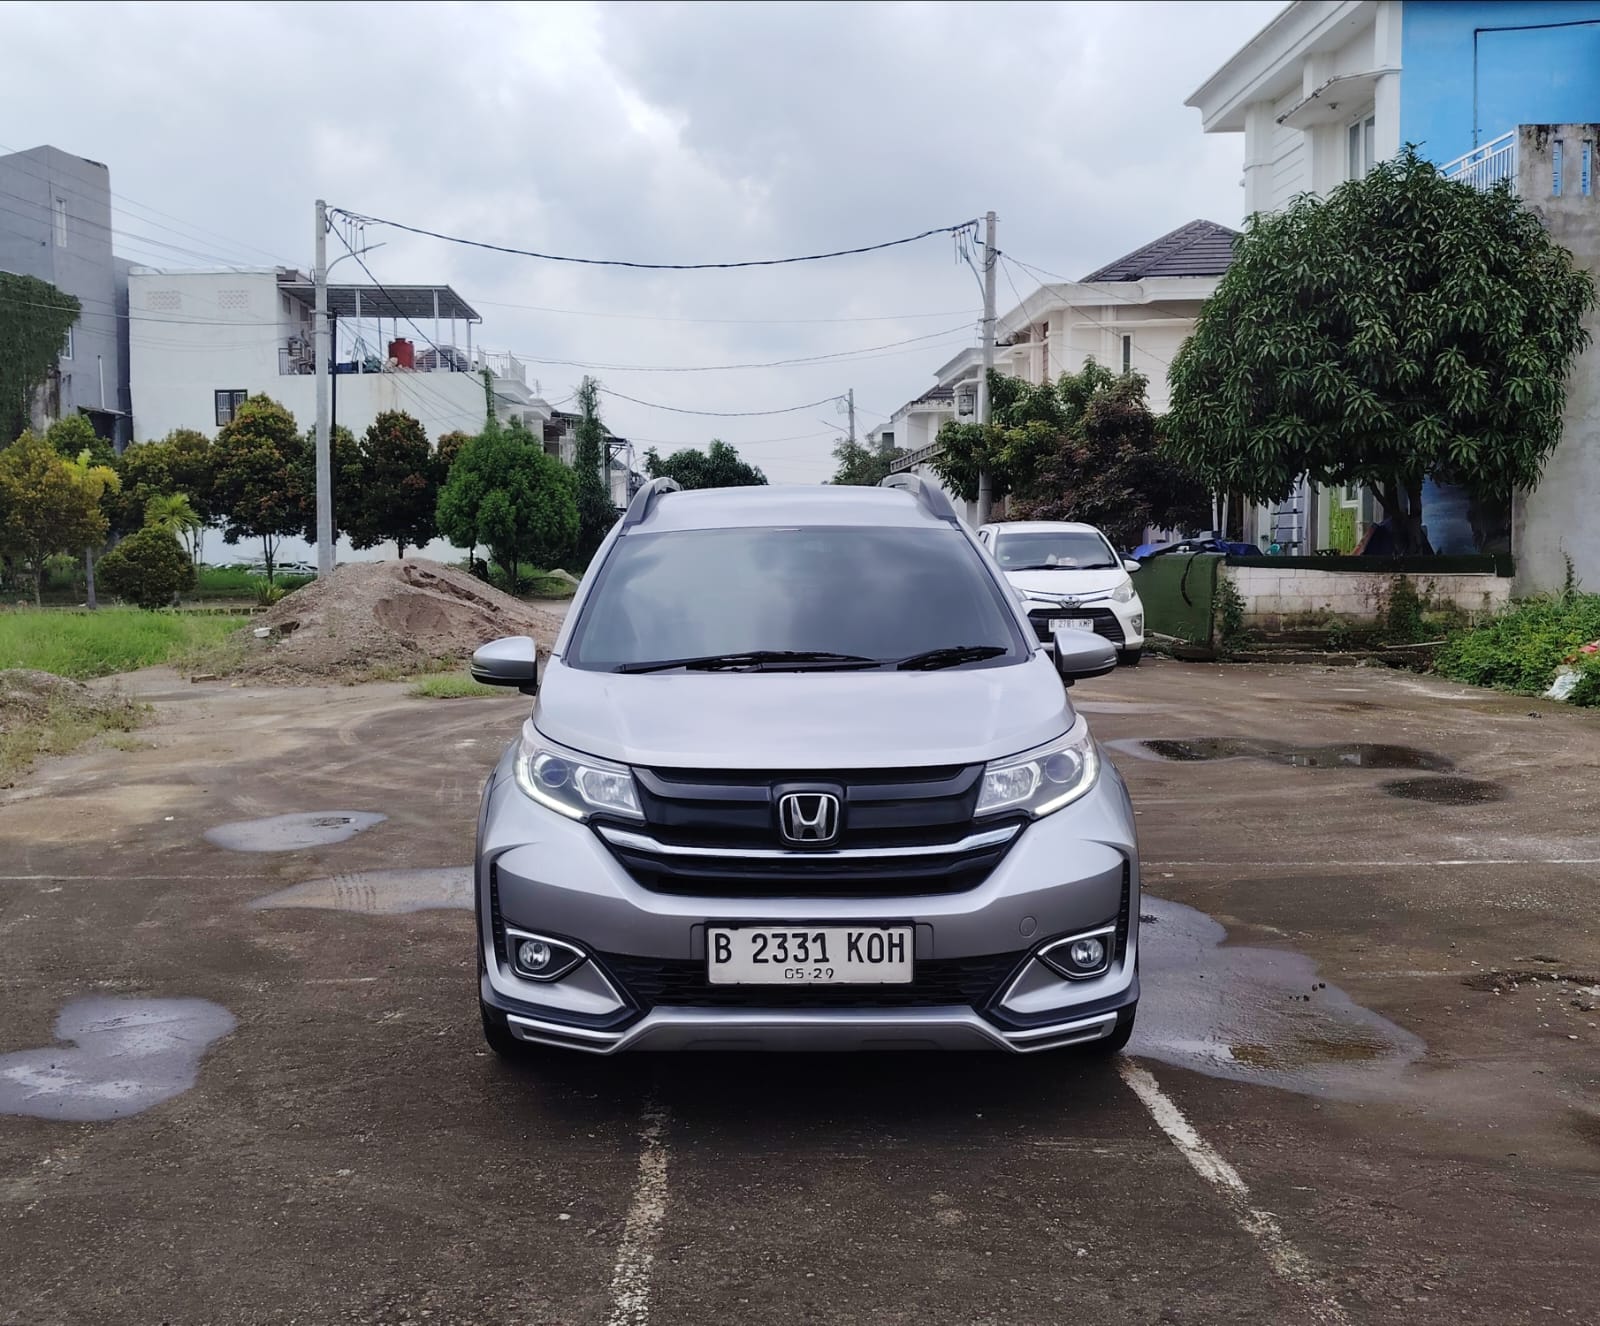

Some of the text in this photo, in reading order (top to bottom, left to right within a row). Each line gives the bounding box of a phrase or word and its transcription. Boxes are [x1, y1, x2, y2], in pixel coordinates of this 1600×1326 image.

[714, 932, 905, 963] B 2331 KOH
